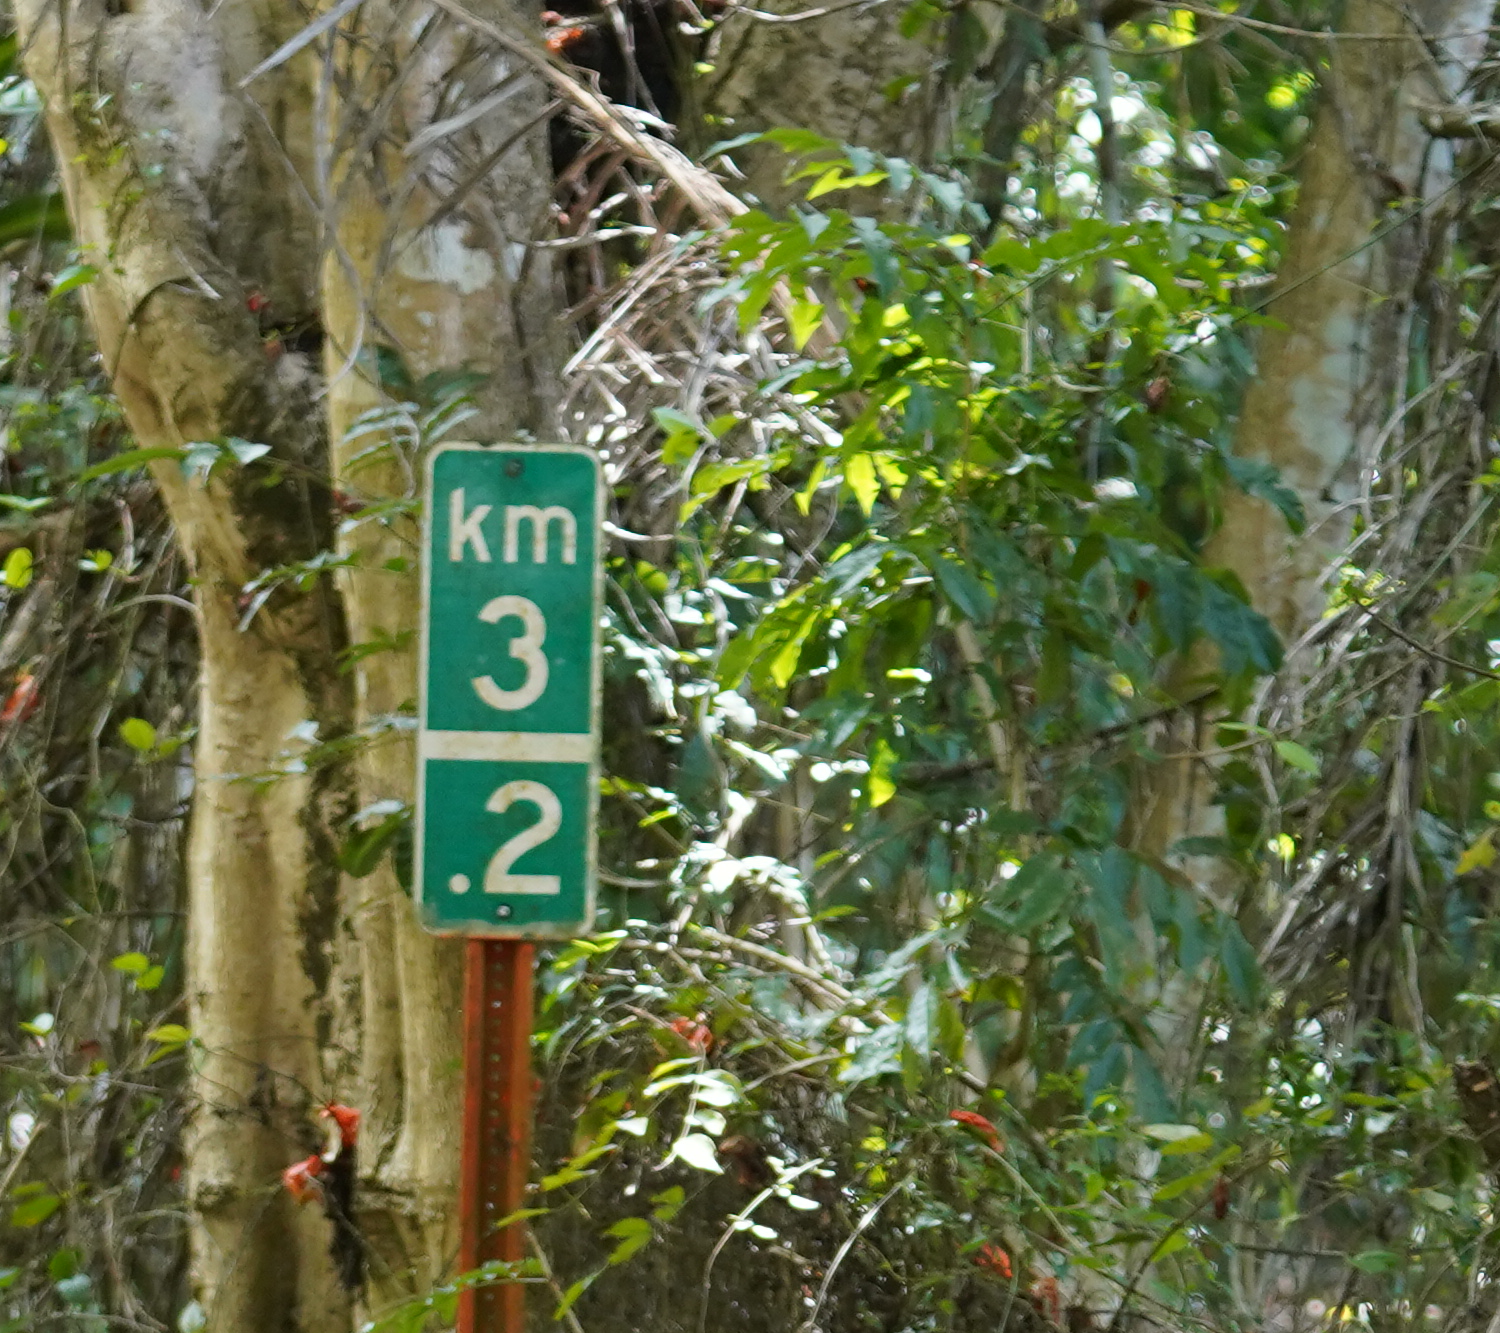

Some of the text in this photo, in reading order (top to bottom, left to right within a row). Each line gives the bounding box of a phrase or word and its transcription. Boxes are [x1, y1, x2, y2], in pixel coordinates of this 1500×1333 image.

[448, 487, 577, 564] km
[472, 595, 549, 711] 3
[448, 780, 563, 895] .2
